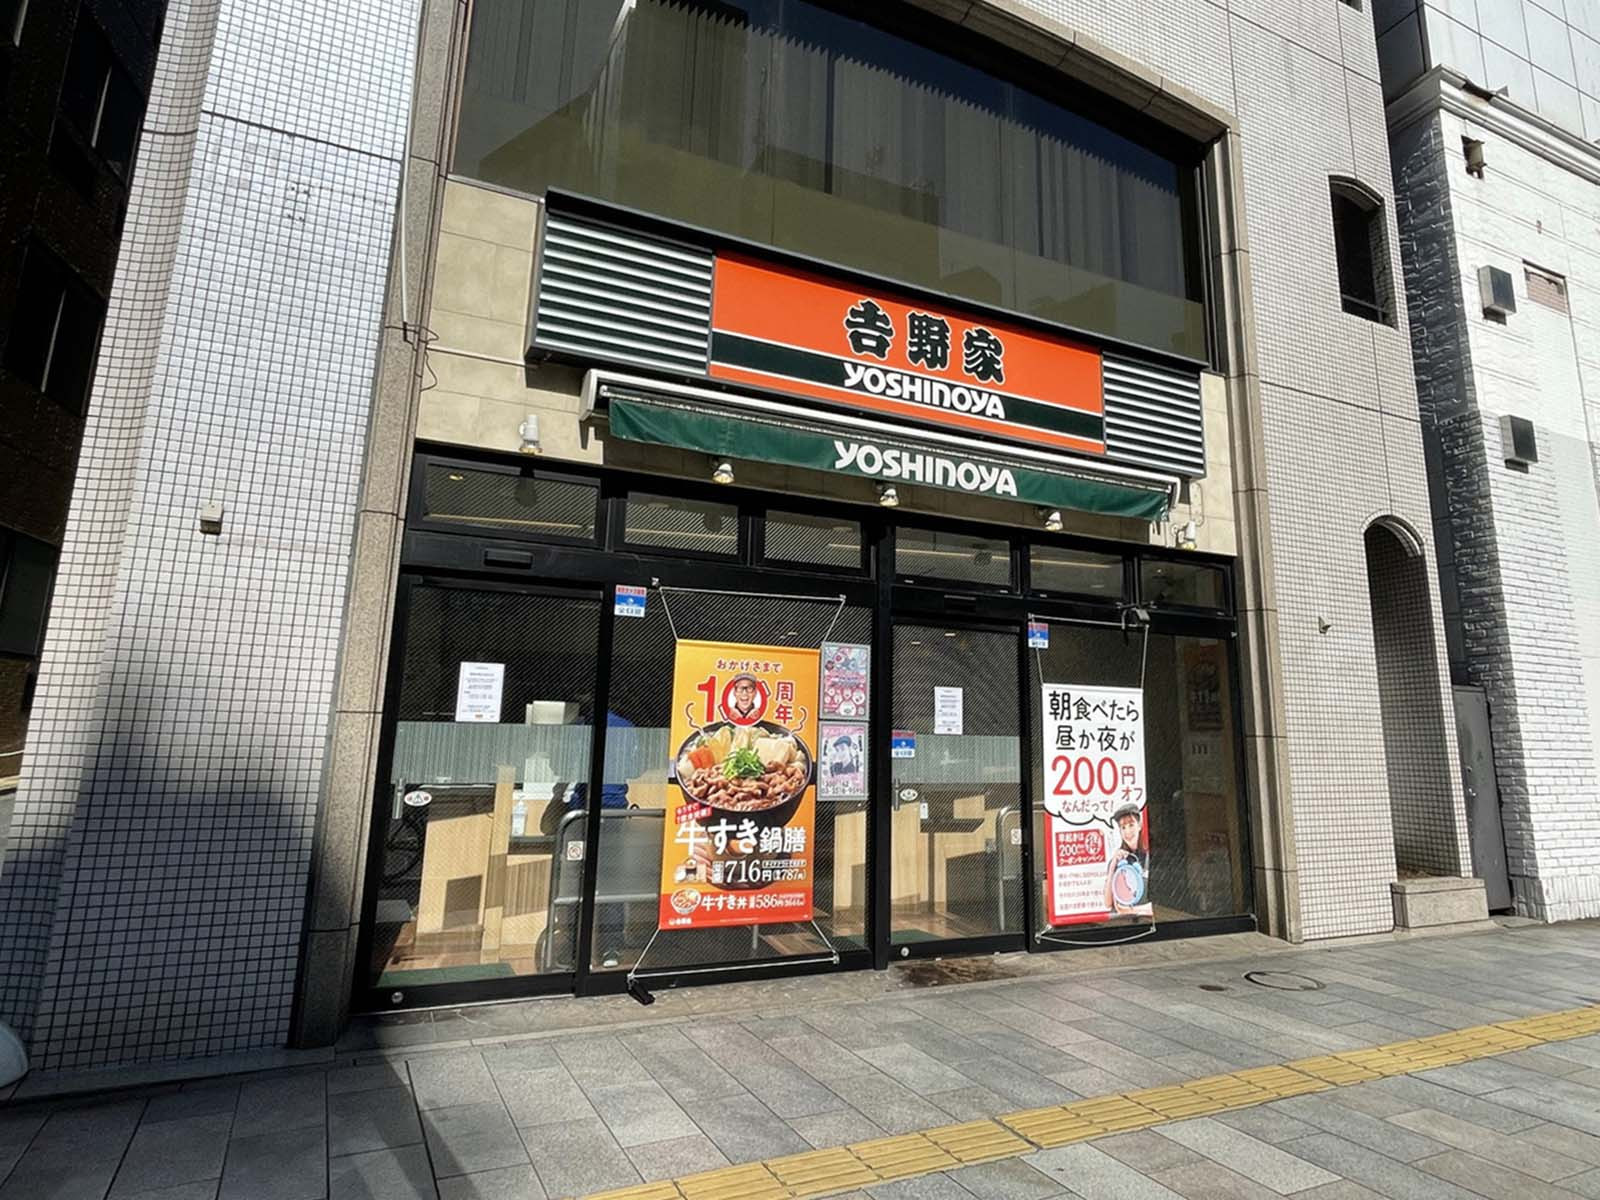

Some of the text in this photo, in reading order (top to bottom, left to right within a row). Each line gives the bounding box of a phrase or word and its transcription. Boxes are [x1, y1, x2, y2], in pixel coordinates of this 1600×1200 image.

[843, 298, 1005, 384] 吉野家
[843, 362, 1006, 419] YOSHINOYA
[834, 440, 1018, 496] YOSHINOYA
[775, 681, 794, 724] 周年
[1048, 690, 1140, 722] 朝食べたら
[1056, 725, 1136, 752] 昼か夜が
[1121, 787, 1144, 802] オフ
[674, 818, 806, 857] 牛すき鍋膳
